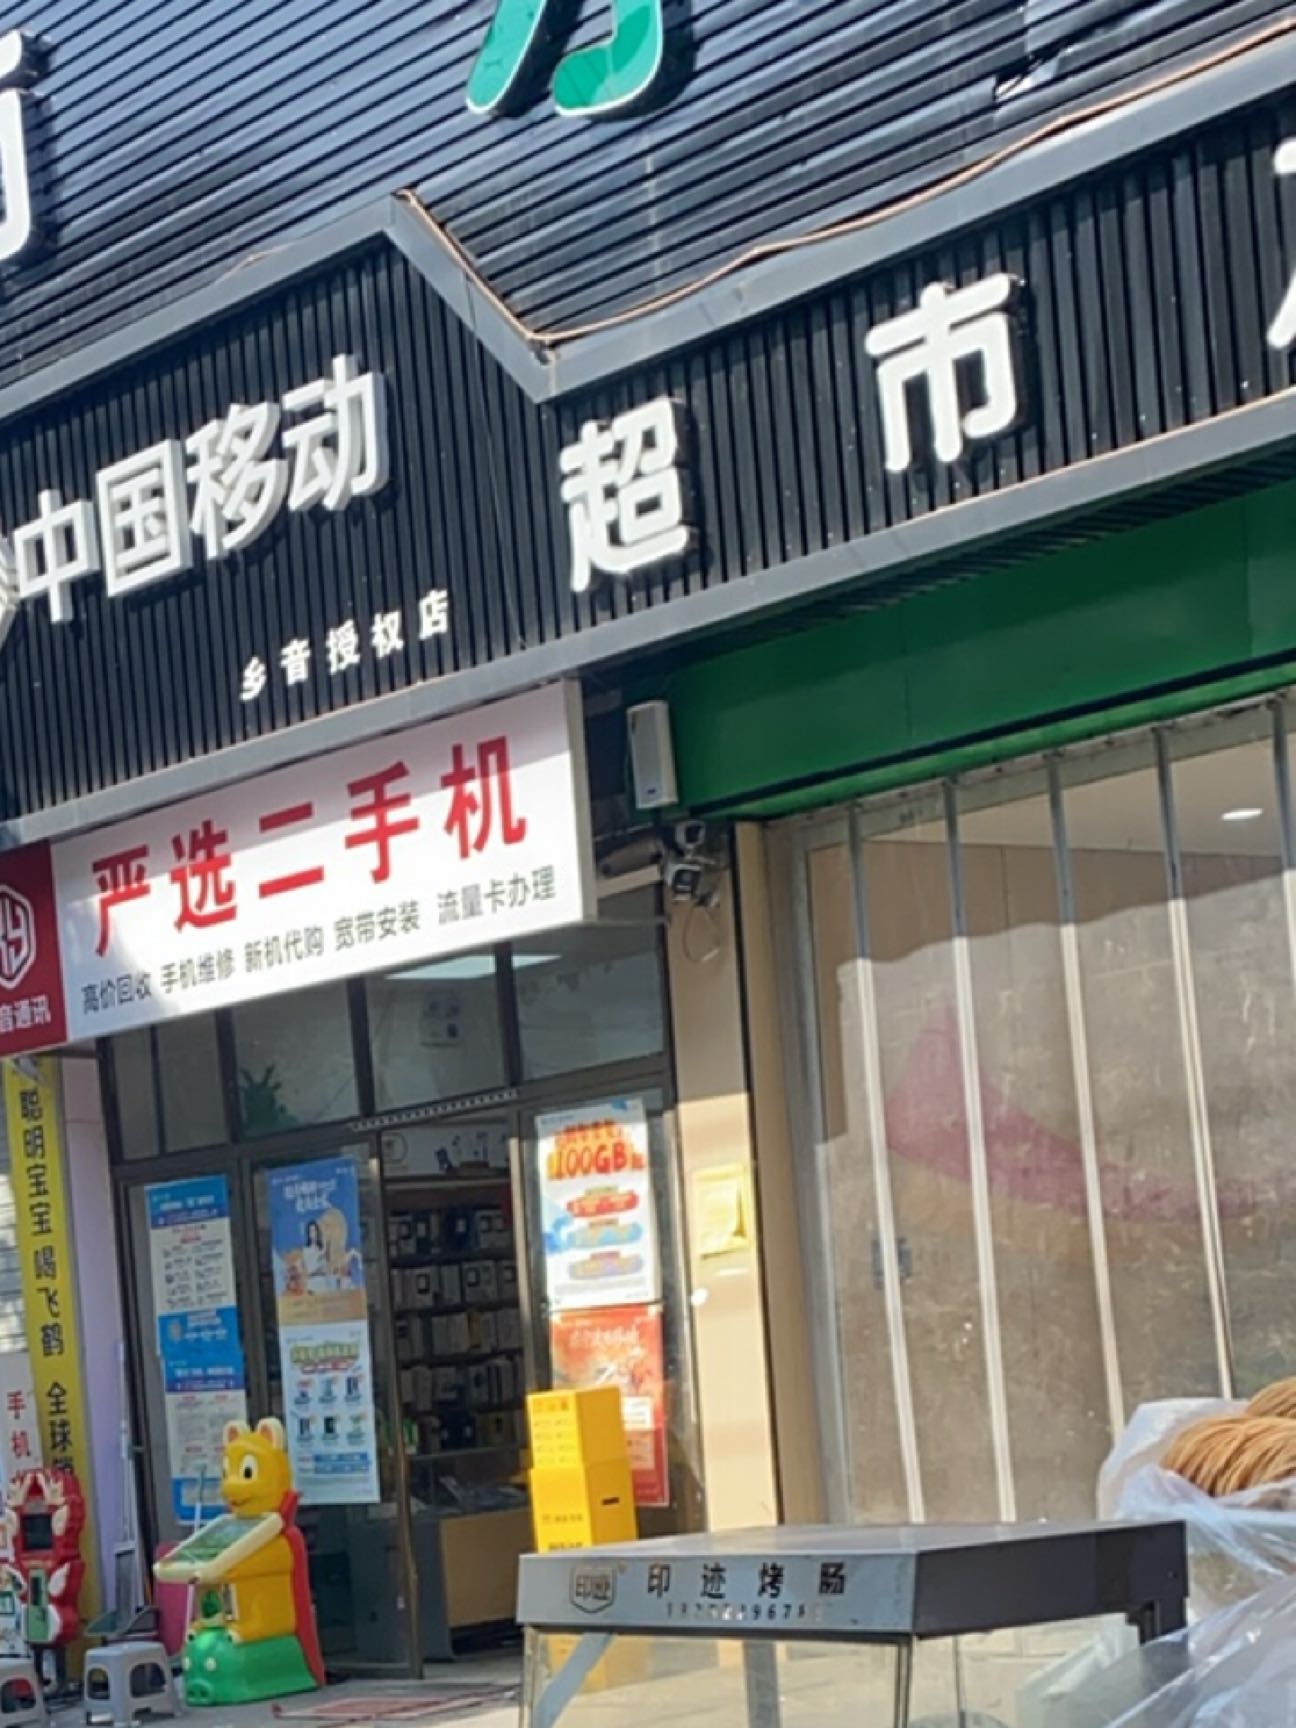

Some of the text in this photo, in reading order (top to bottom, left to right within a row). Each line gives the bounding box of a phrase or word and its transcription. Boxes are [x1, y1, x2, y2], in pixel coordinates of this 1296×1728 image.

[14, 353, 388, 622] 中国移动
[240, 588, 450, 700] 乡音授权店
[91, 735, 529, 957] 严选二手机
[82, 865, 556, 1016] 高价回收 手机维修 新机代购 宽带安装 流量卡办理
[647, 1561, 846, 1600] 印迹烤肠
